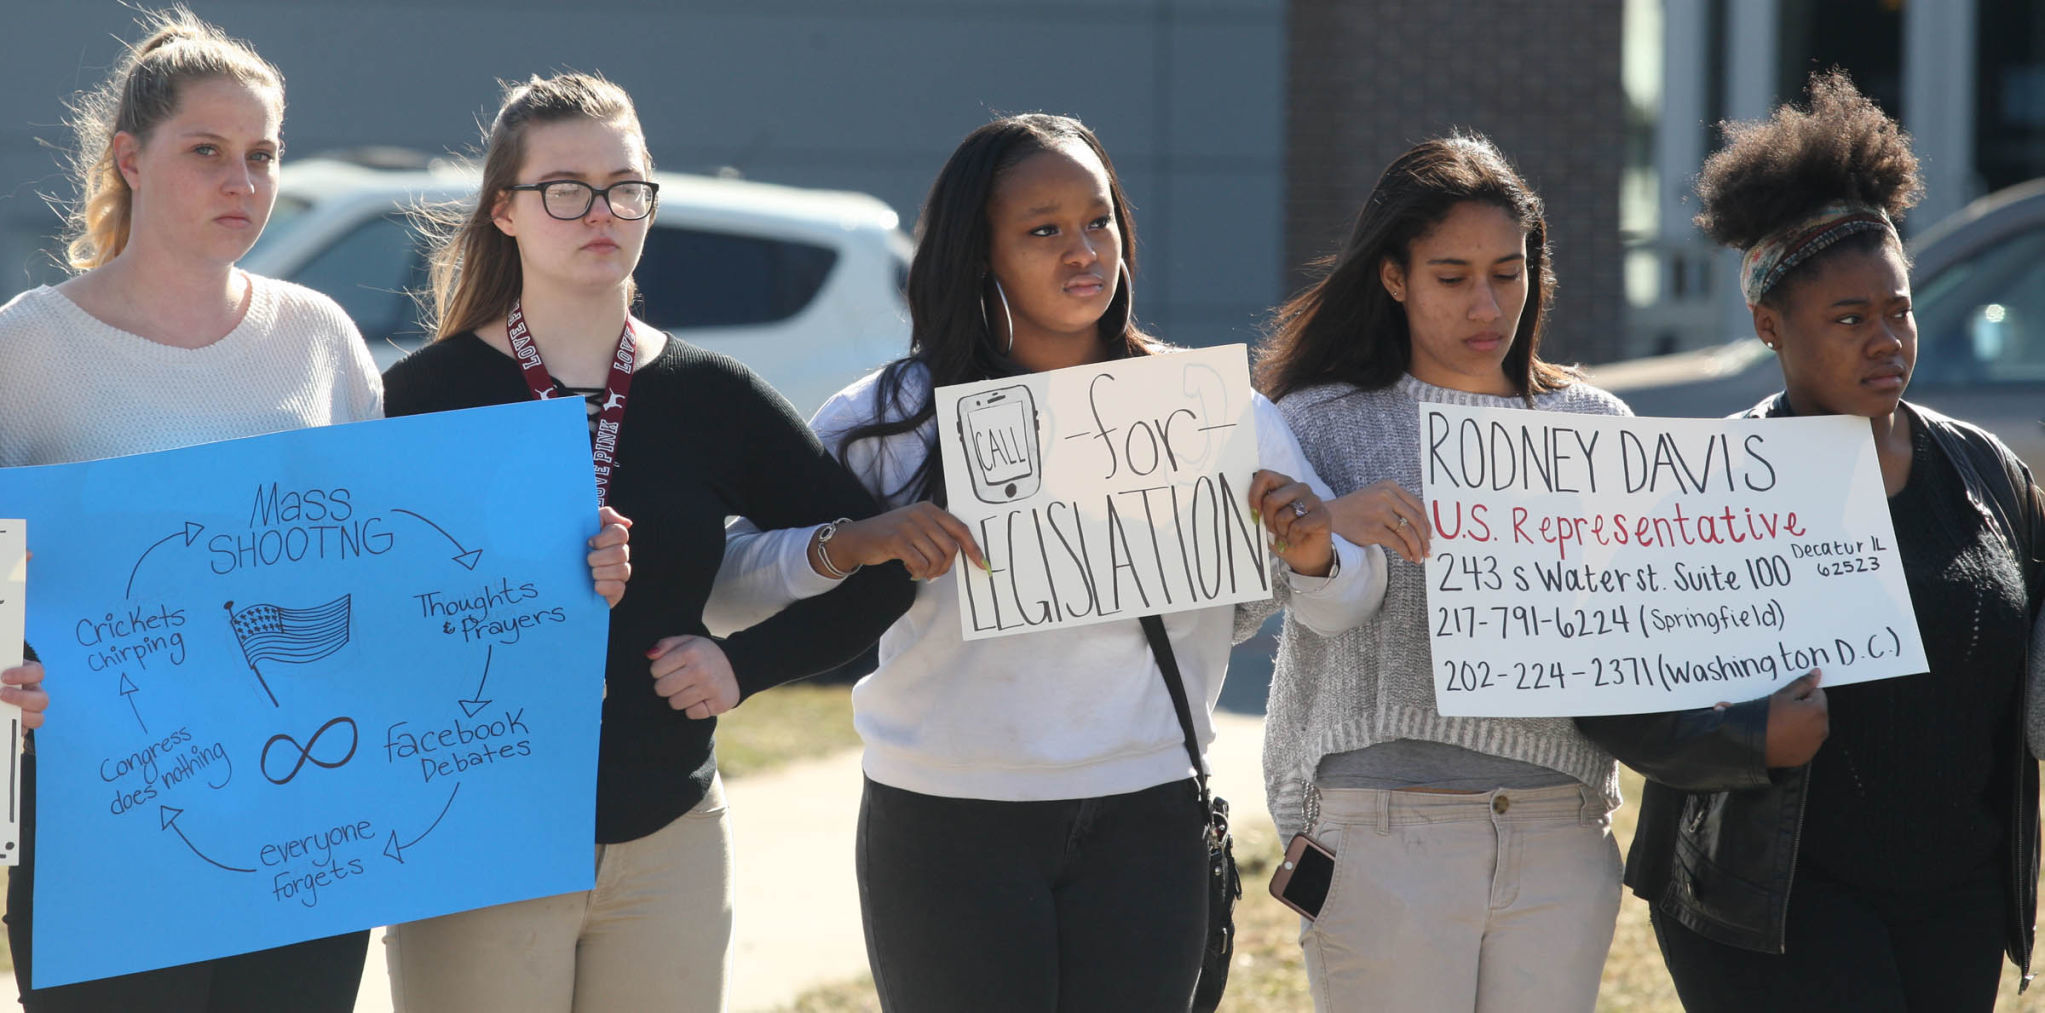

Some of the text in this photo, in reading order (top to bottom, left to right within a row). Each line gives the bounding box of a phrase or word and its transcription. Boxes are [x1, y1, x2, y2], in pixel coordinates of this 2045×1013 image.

[509, 322, 542, 371] LOVE
[613, 326, 636, 375] LOVE
[593, 418, 619, 463] PINK
[975, 426, 1027, 472] CALL
[1429, 411, 1777, 495] RODNEY DAVIS
[208, 517, 394, 575] SHOOTNG
[960, 471, 1268, 632] LEGISLATION
[1432, 499, 1806, 561] U.S. Representative
[1791, 540, 1864, 559] Decatur
[1437, 552, 1503, 592] 243
[1674, 561, 1741, 592] Suite
[1746, 554, 1792, 590] 100
[1817, 557, 1881, 577] 62523
[413, 577, 539, 622] Thoughts
[1436, 599, 1786, 640] 217-791-6224 (Springfield)
[76, 604, 186, 647] Crickets
[461, 606, 566, 645] Prayers
[100, 727, 192, 785] Congress
[110, 741, 232, 815] does nothing
[421, 739, 532, 784] Debates
[260, 820, 376, 868] everyone
